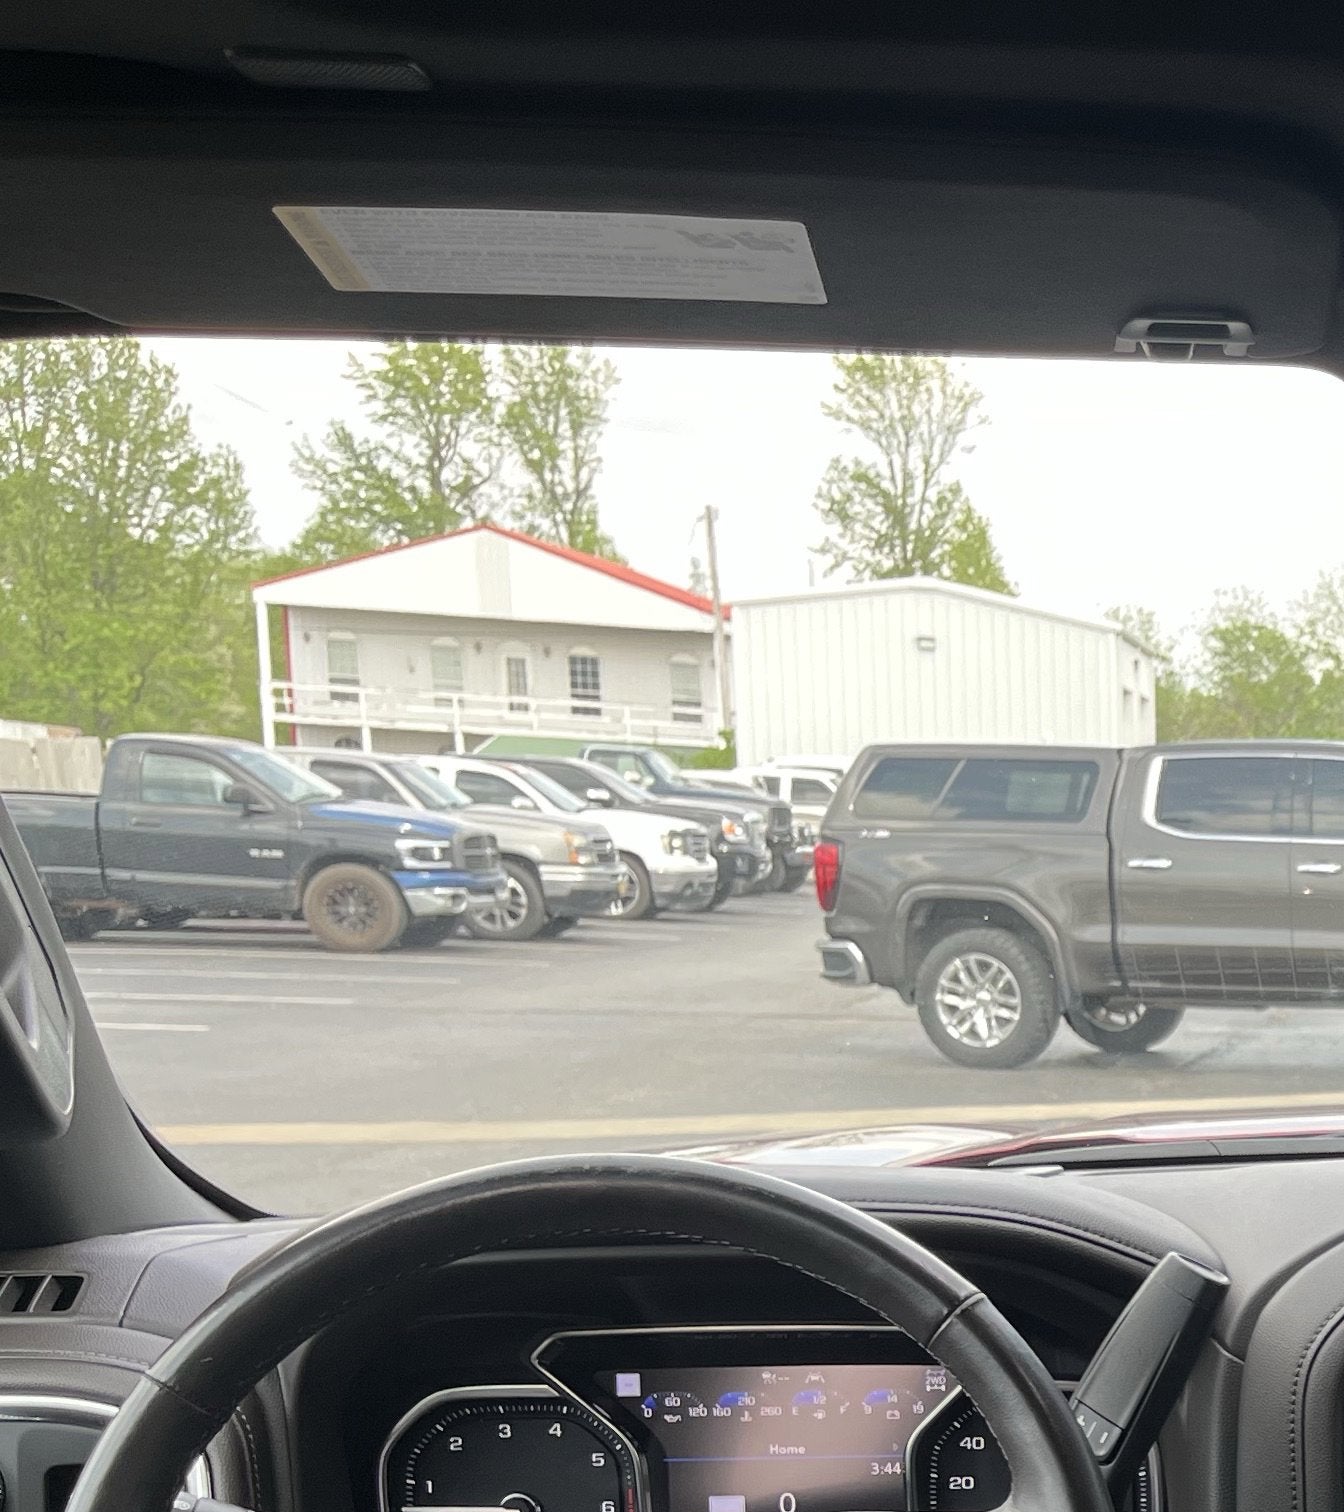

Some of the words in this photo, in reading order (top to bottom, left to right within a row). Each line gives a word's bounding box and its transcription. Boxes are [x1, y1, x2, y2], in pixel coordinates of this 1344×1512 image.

[925, 1376, 946, 1385] 2WD
[664, 1397, 681, 1407] 60
[887, 1395, 898, 1404] 14
[644, 1407, 653, 1418] 0
[688, 1406, 708, 1418] 120
[761, 1406, 783, 1416] 260
[792, 1406, 799, 1416] E
[498, 1423, 512, 1439] 3
[548, 1422, 562, 1438] 4
[449, 1436, 463, 1451] 2
[769, 1443, 806, 1455] Home
[959, 1436, 985, 1450] 40
[591, 1452, 605, 1467] 5
[870, 1462, 902, 1475] 3:44
[426, 1480, 433, 1494] 1
[949, 1476, 975, 1490] 20
